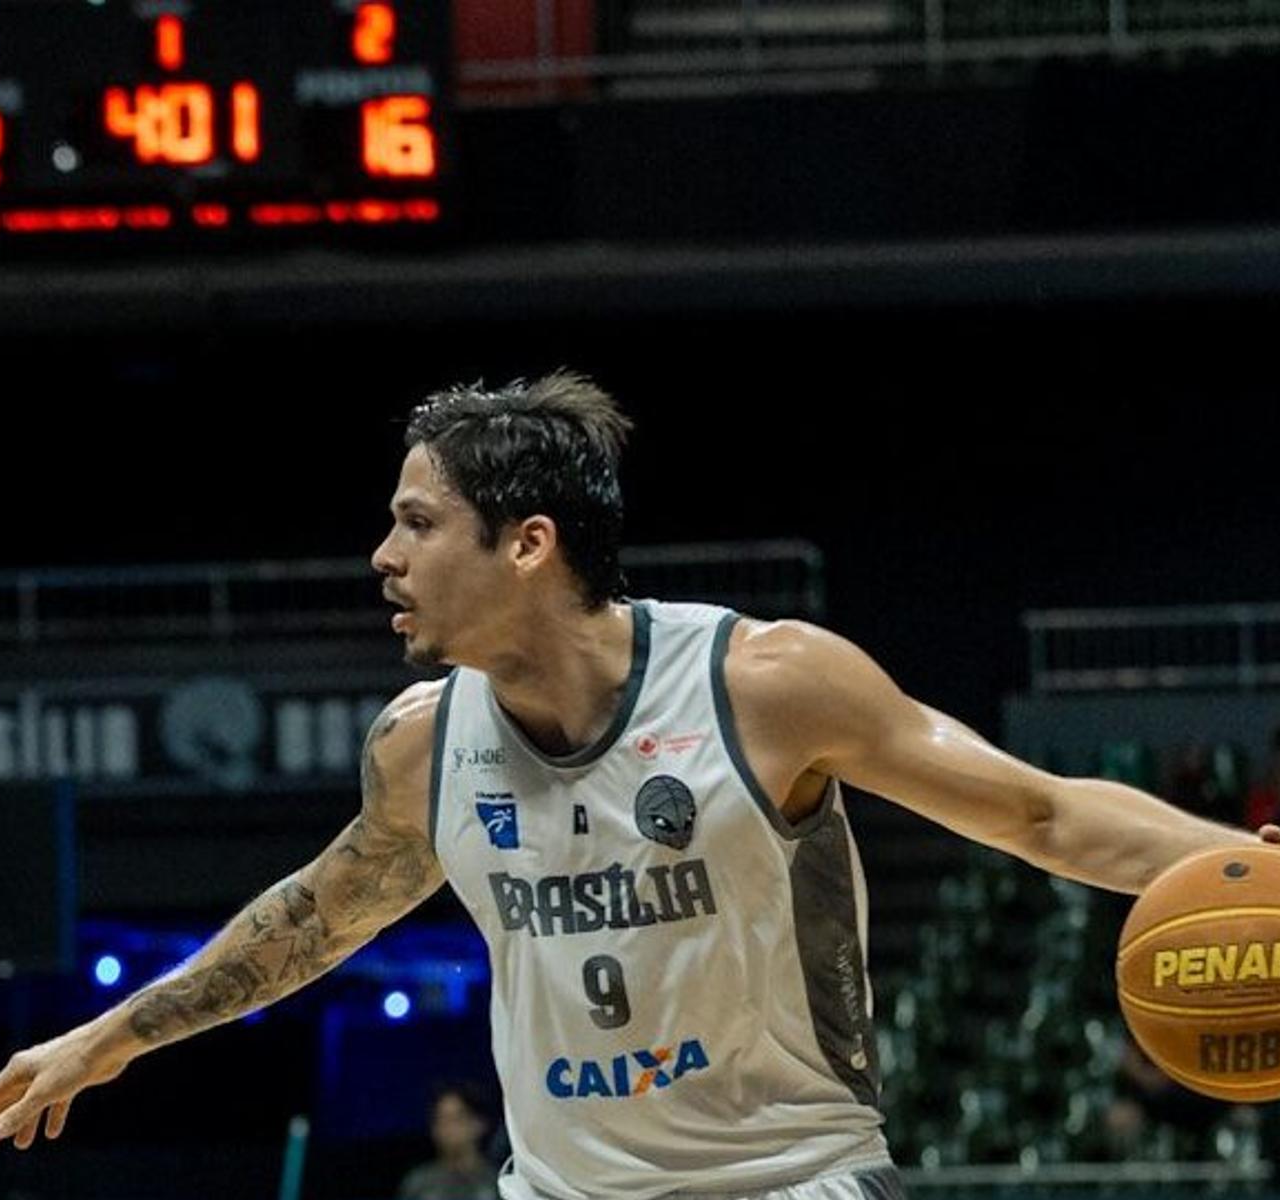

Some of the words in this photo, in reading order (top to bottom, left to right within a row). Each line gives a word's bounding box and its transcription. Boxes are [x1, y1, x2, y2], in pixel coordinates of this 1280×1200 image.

[361, 95, 436, 178] 16
[582, 954, 632, 1031] 9
[546, 1038, 710, 1098] CAIXA
